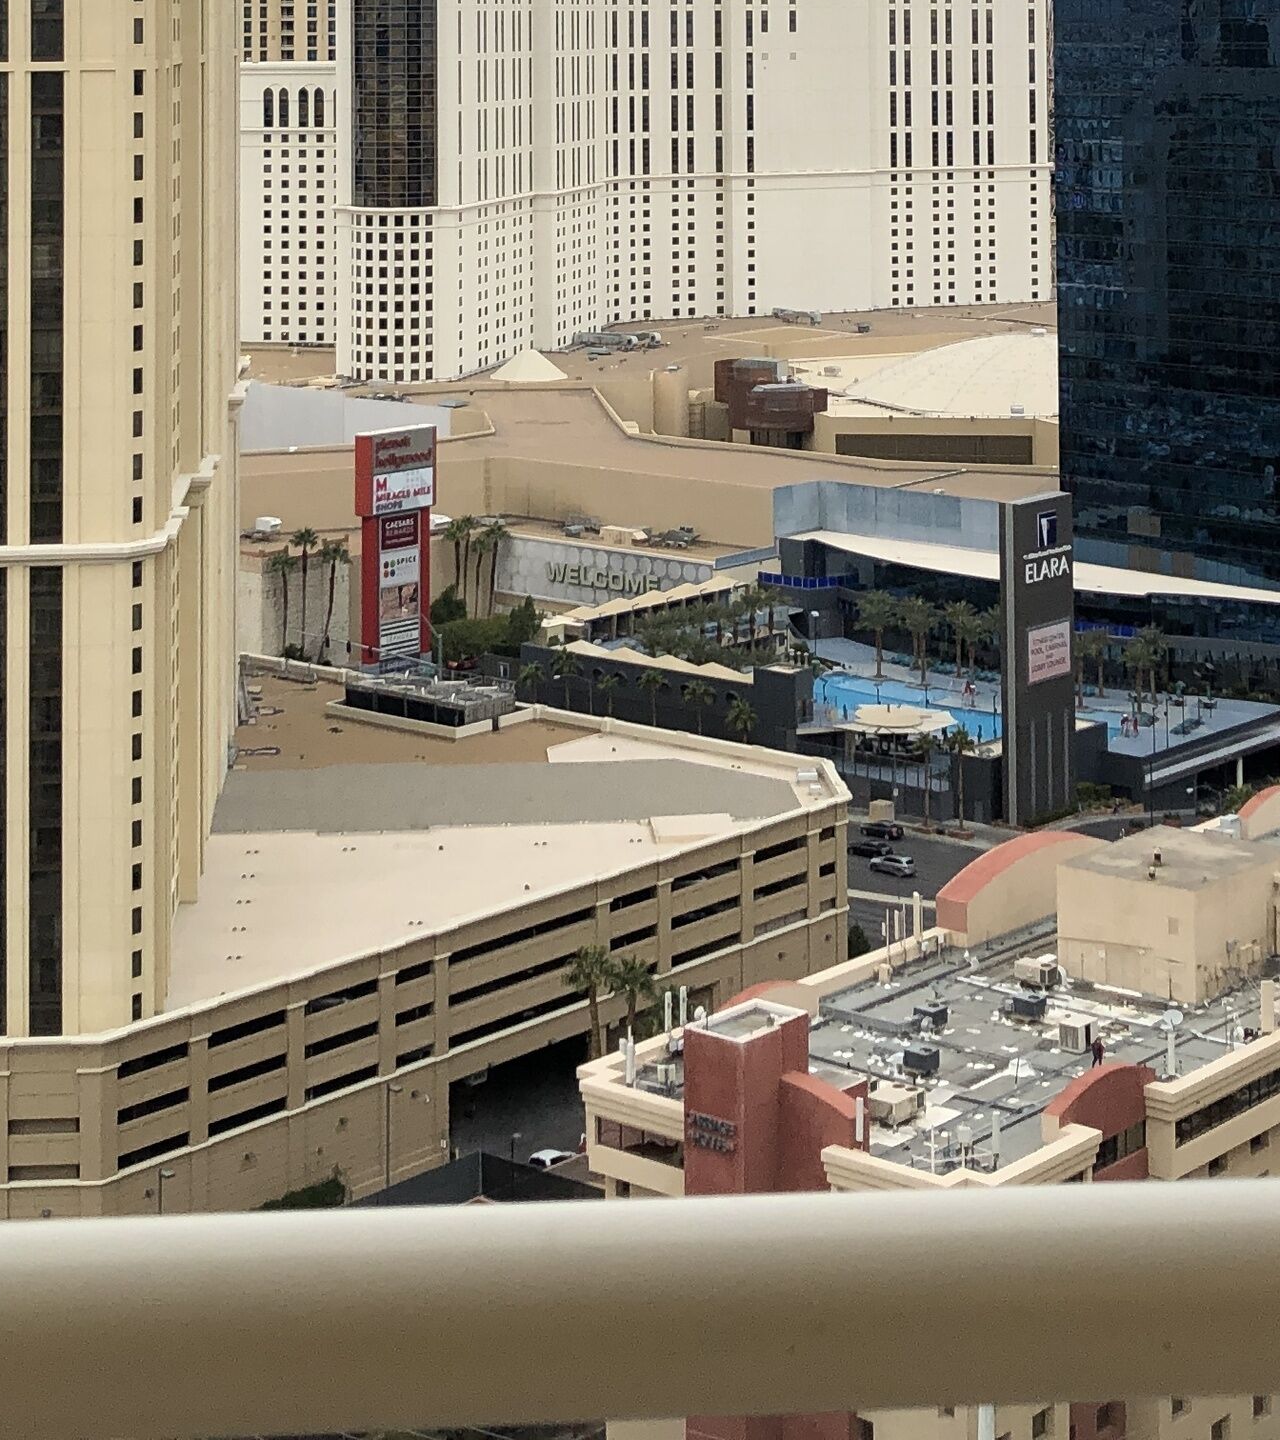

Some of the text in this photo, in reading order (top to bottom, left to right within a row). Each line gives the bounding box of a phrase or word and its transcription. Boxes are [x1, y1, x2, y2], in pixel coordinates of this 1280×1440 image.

[376, 486, 432, 502] MIRACLE MILE
[385, 517, 414, 529] CAESARS
[396, 555, 417, 566] SPICE
[545, 561, 659, 594] WELCOME
[1025, 555, 1070, 584] ELARA
